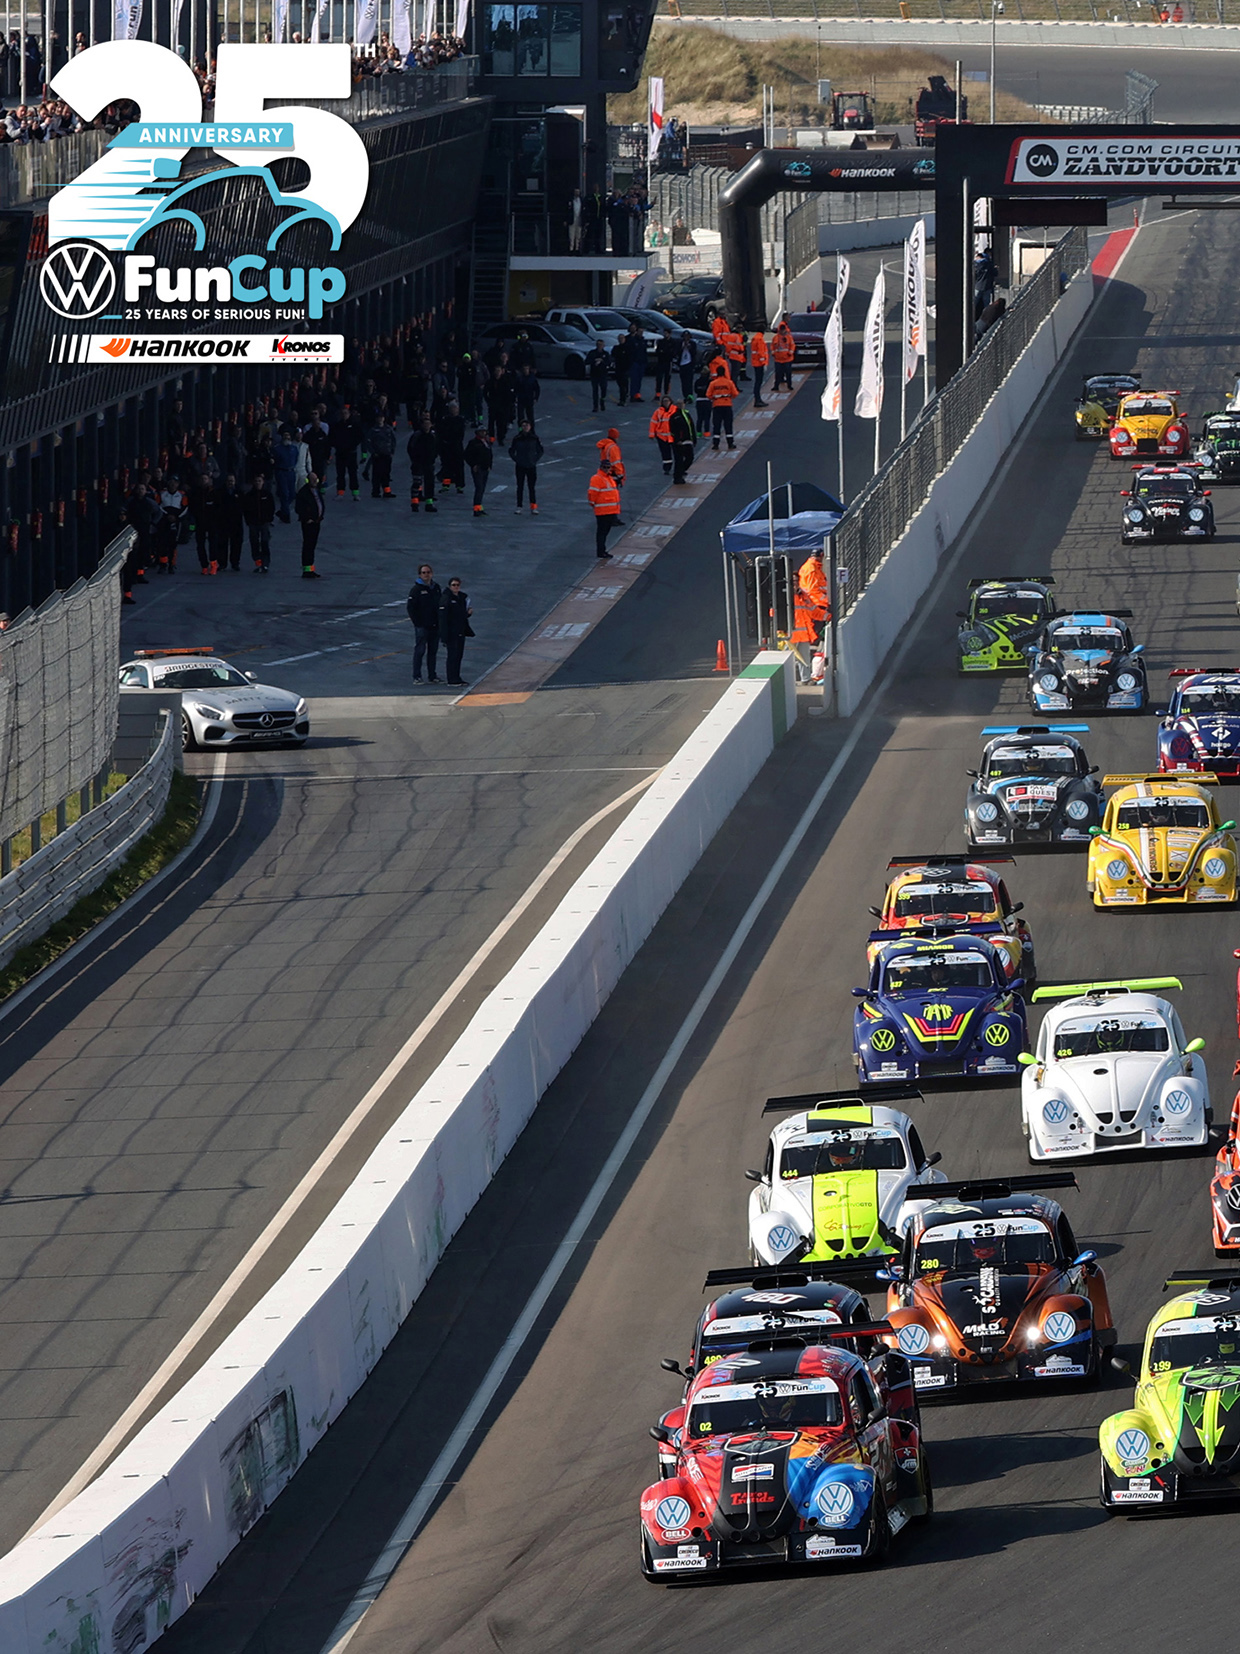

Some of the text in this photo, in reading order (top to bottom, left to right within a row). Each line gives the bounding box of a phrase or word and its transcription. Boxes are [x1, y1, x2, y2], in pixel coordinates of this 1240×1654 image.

[1067, 145, 1153, 155] CM.COM
[1154, 797, 1169, 807] 25
[1101, 1020, 1120, 1031] 25
[831, 1129, 853, 1142] 25
[782, 1169, 798, 1178] 444
[972, 1223, 995, 1237] 25
[1008, 1224, 1039, 1232] FunCup
[921, 1259, 940, 1269] 280
[1213, 1316, 1238, 1331] 25
[973, 1329, 1005, 1337] RACING
[1153, 1360, 1171, 1372] 199
[752, 1382, 778, 1399] 25
[791, 1383, 826, 1393] FunCup
[700, 1422, 712, 1431] 02
[1120, 1491, 1160, 1500] HANKOOK
[825, 1515, 847, 1524] BELL
[817, 1546, 858, 1556] HANKOOK
[663, 1559, 703, 1567] HANKOOK
